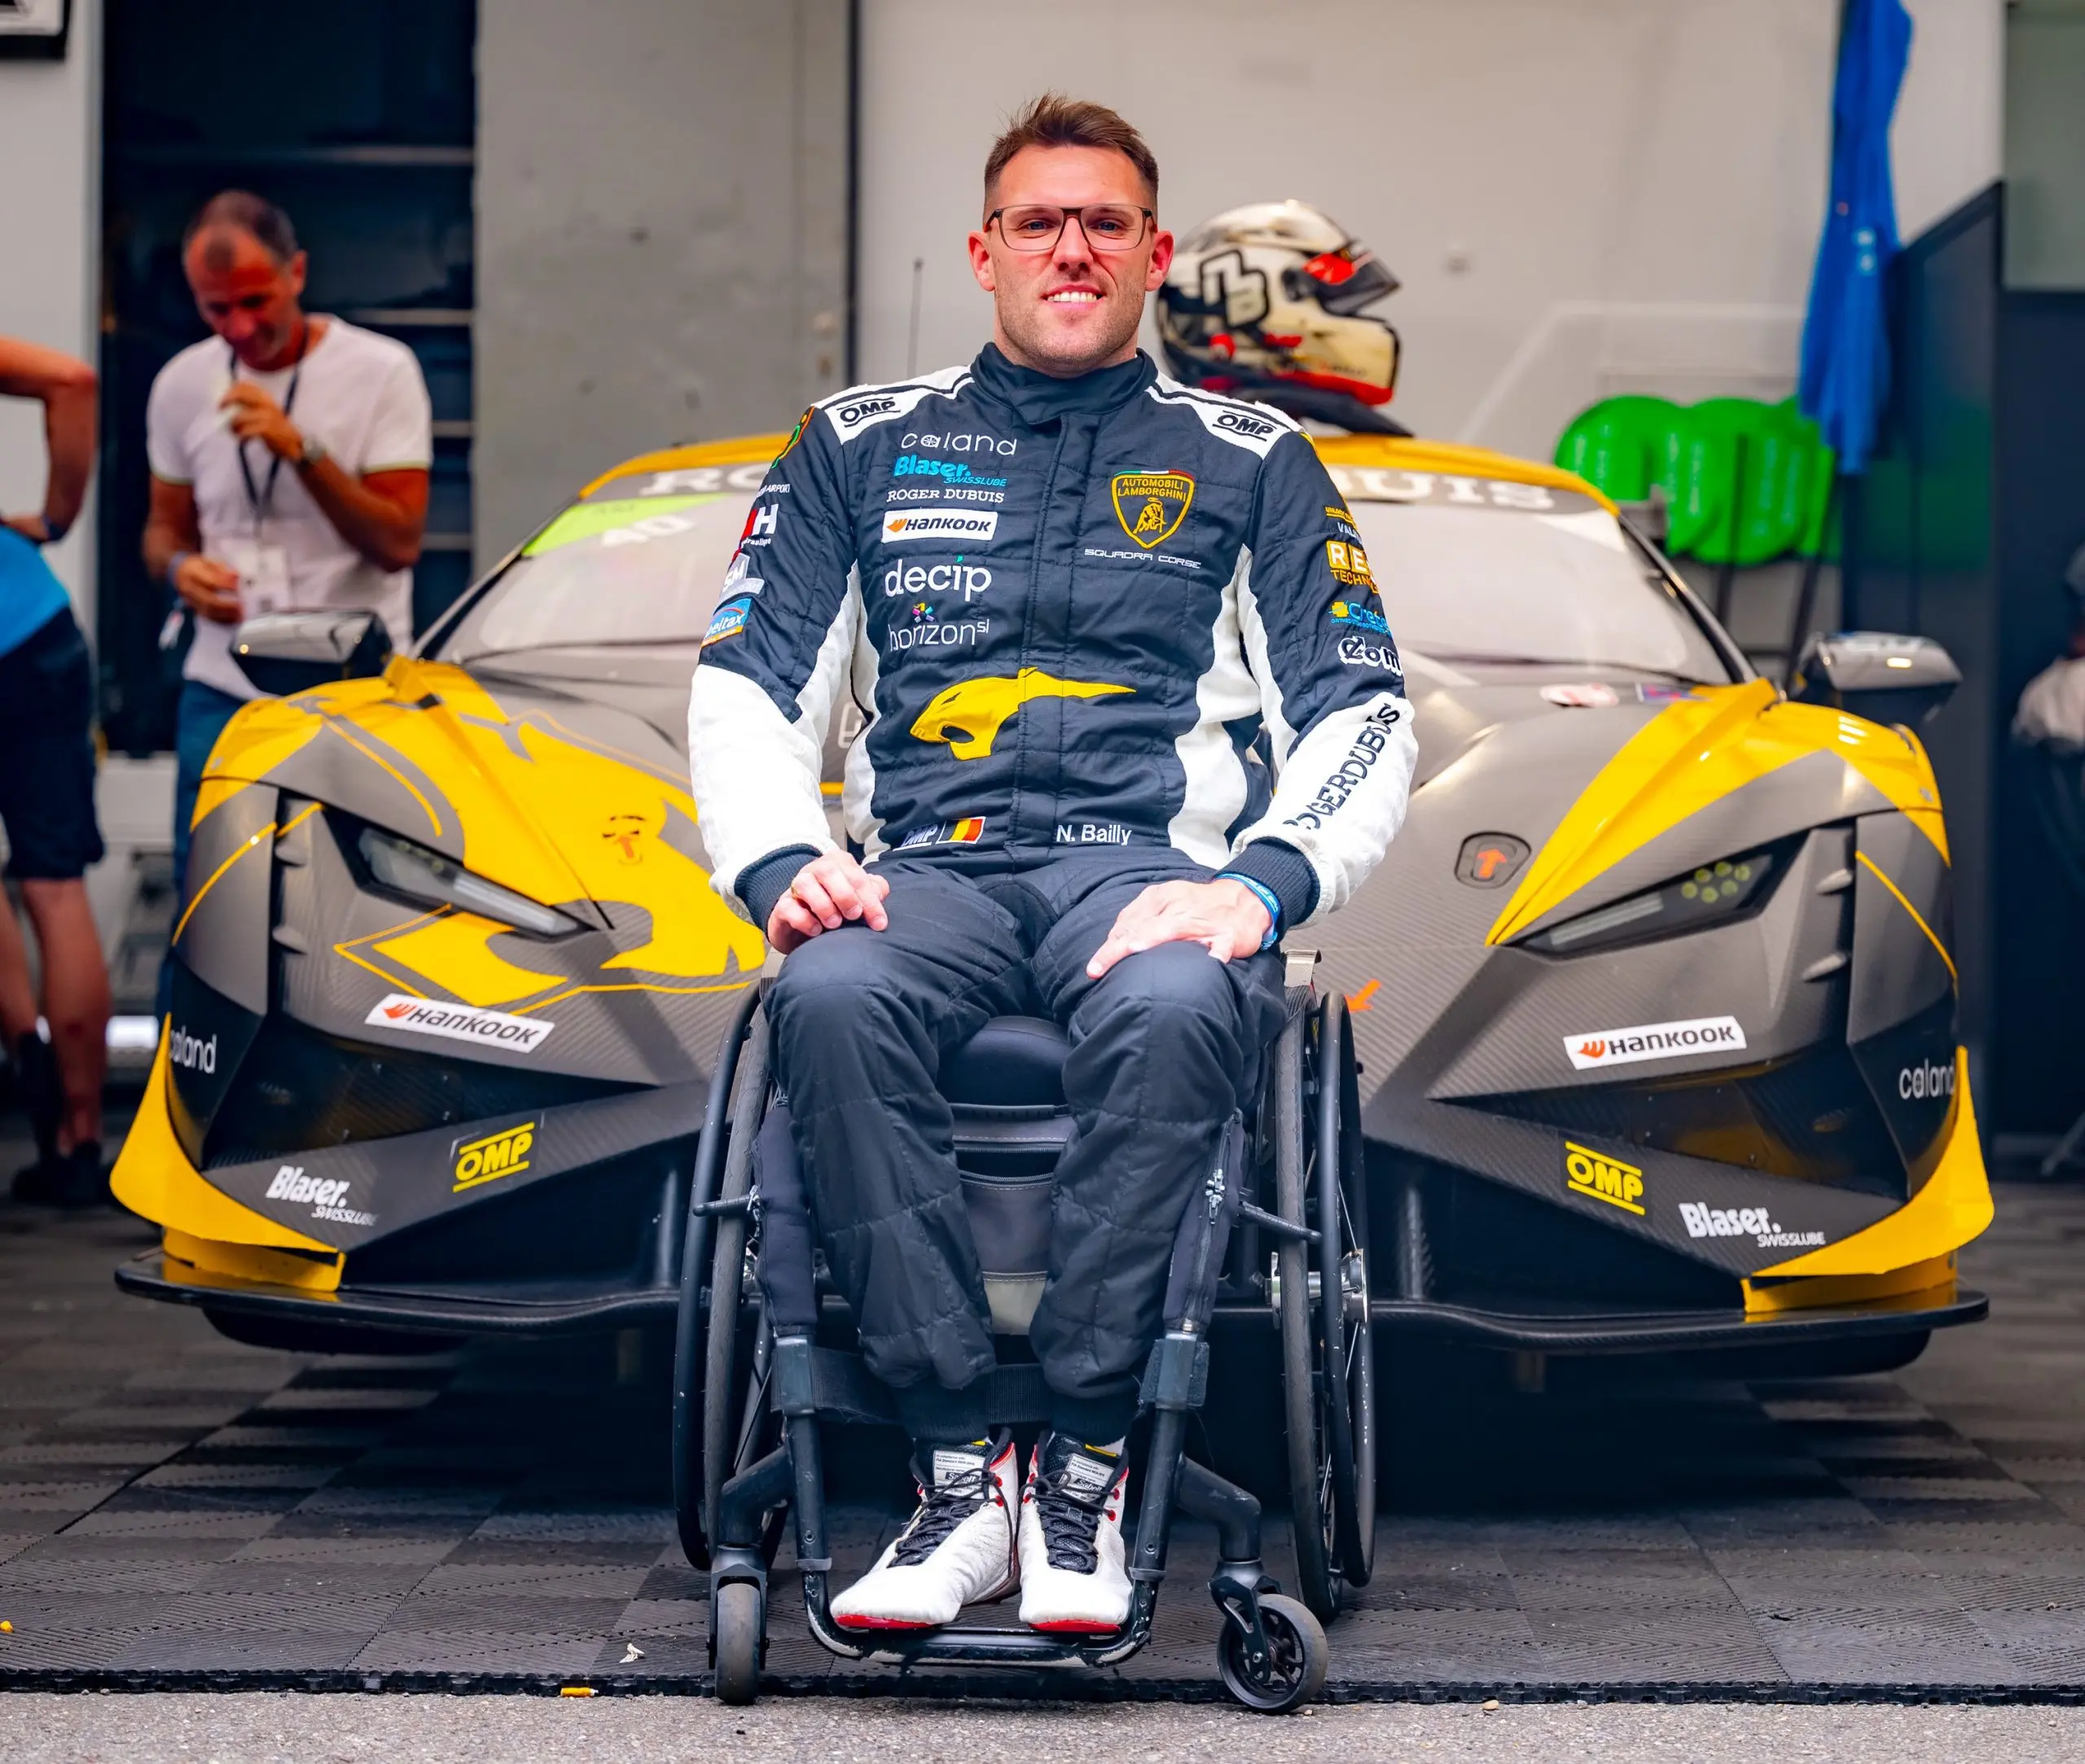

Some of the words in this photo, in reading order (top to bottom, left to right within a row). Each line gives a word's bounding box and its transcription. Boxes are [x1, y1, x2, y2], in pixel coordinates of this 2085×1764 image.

[840, 400, 895, 422] OMP
[1217, 414, 1275, 435] OMP
[901, 432, 1017, 455] caland
[943, 475, 1008, 487] SWISSLUBE
[1122, 478, 1183, 489] AUTOMOBILI
[886, 489, 940, 502] ROGER
[943, 489, 1005, 503] DUBUIS
[1117, 488, 1187, 502] LAMBORGHINI
[1084, 548, 1152, 560] SQUADRA
[1158, 555, 1201, 569] CORSE
[885, 555, 992, 602] decip
[1057, 825, 1074, 843] N.
[1081, 824, 1132, 846] Bailly
[455, 1132, 533, 1181] OMP
[1567, 1152, 1644, 1203] OMP
